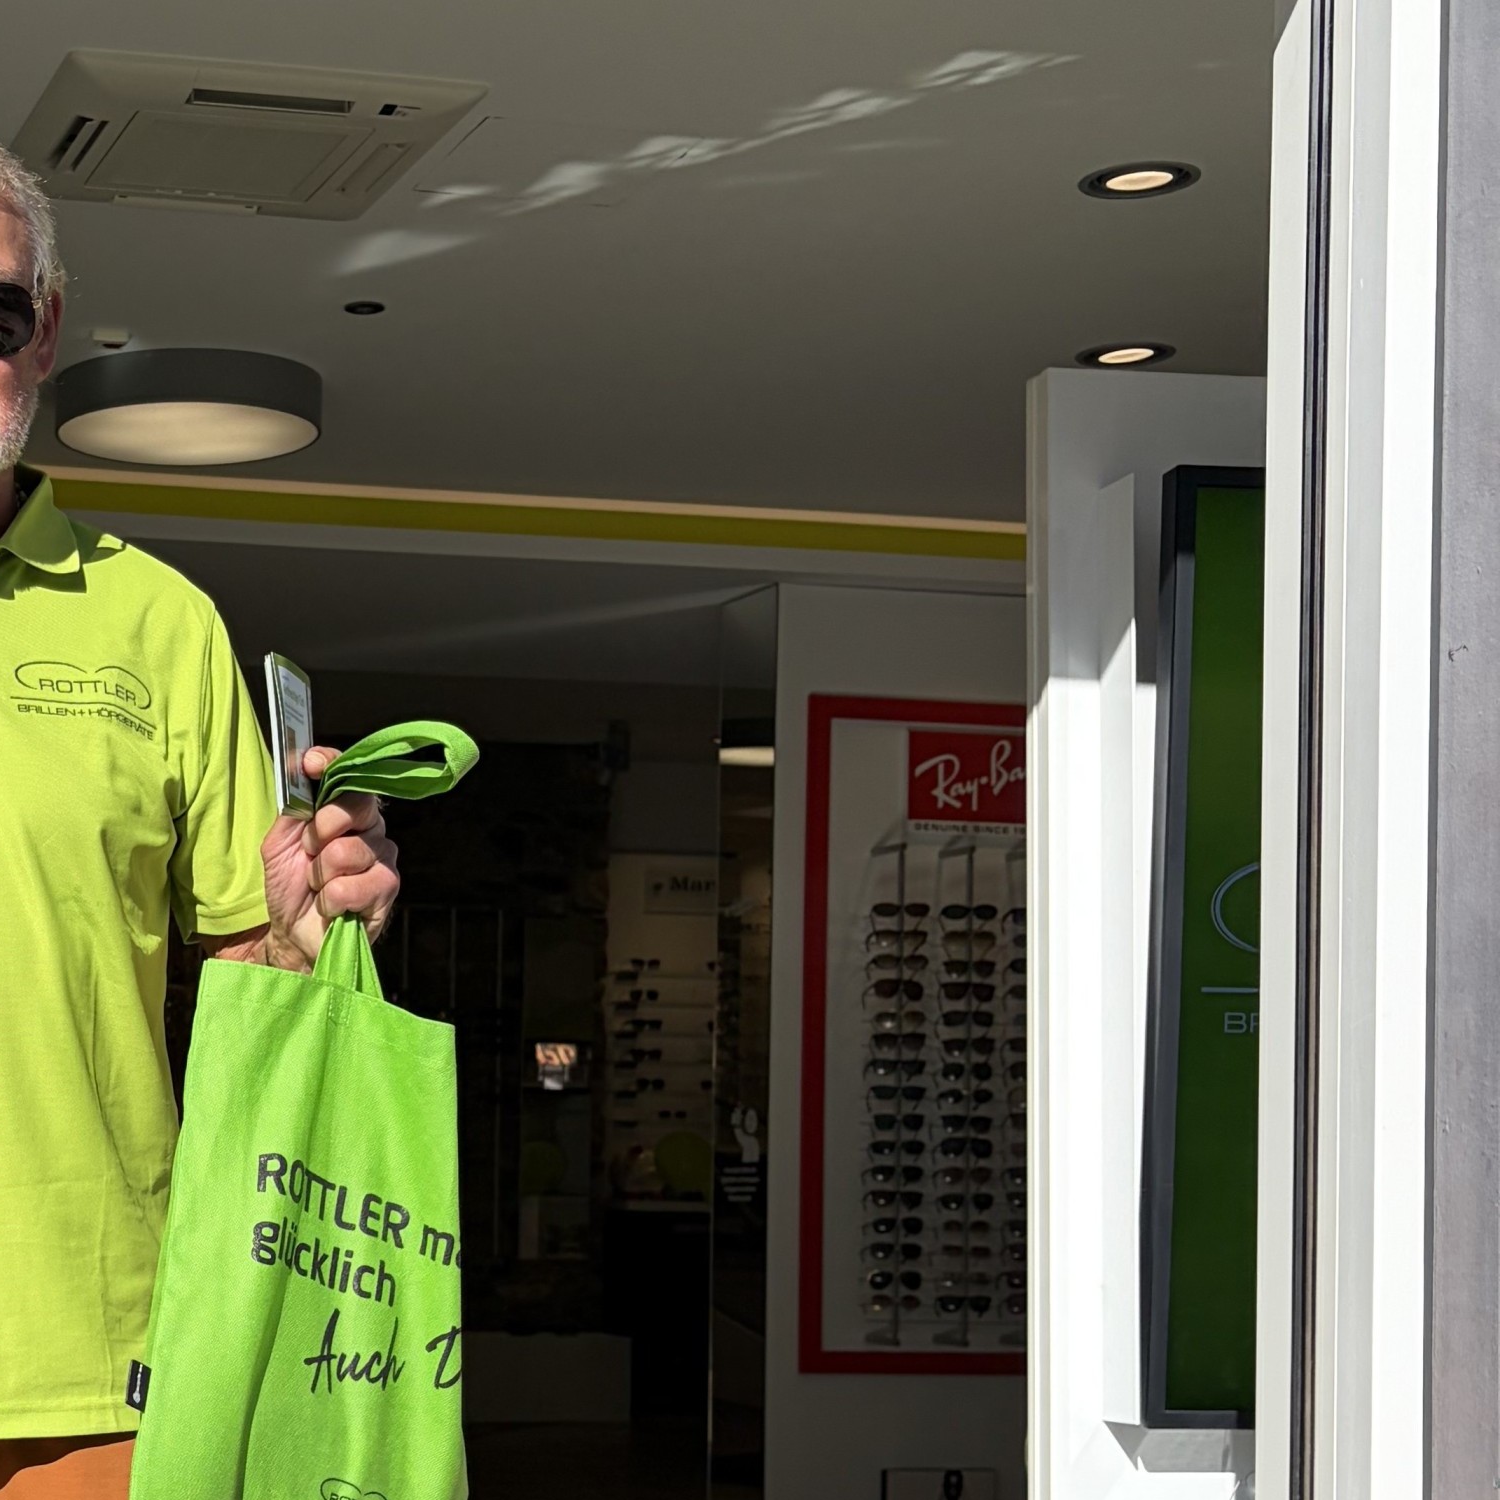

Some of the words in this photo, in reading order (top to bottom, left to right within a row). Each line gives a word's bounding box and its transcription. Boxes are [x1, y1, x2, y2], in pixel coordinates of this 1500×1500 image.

[38, 678, 137, 707] ROTTLER
[973, 825, 1009, 835] SINCE
[255, 1152, 411, 1250] ROTTLER
[250, 1219, 397, 1307] glücklich
[304, 1308, 405, 1395] Auch
